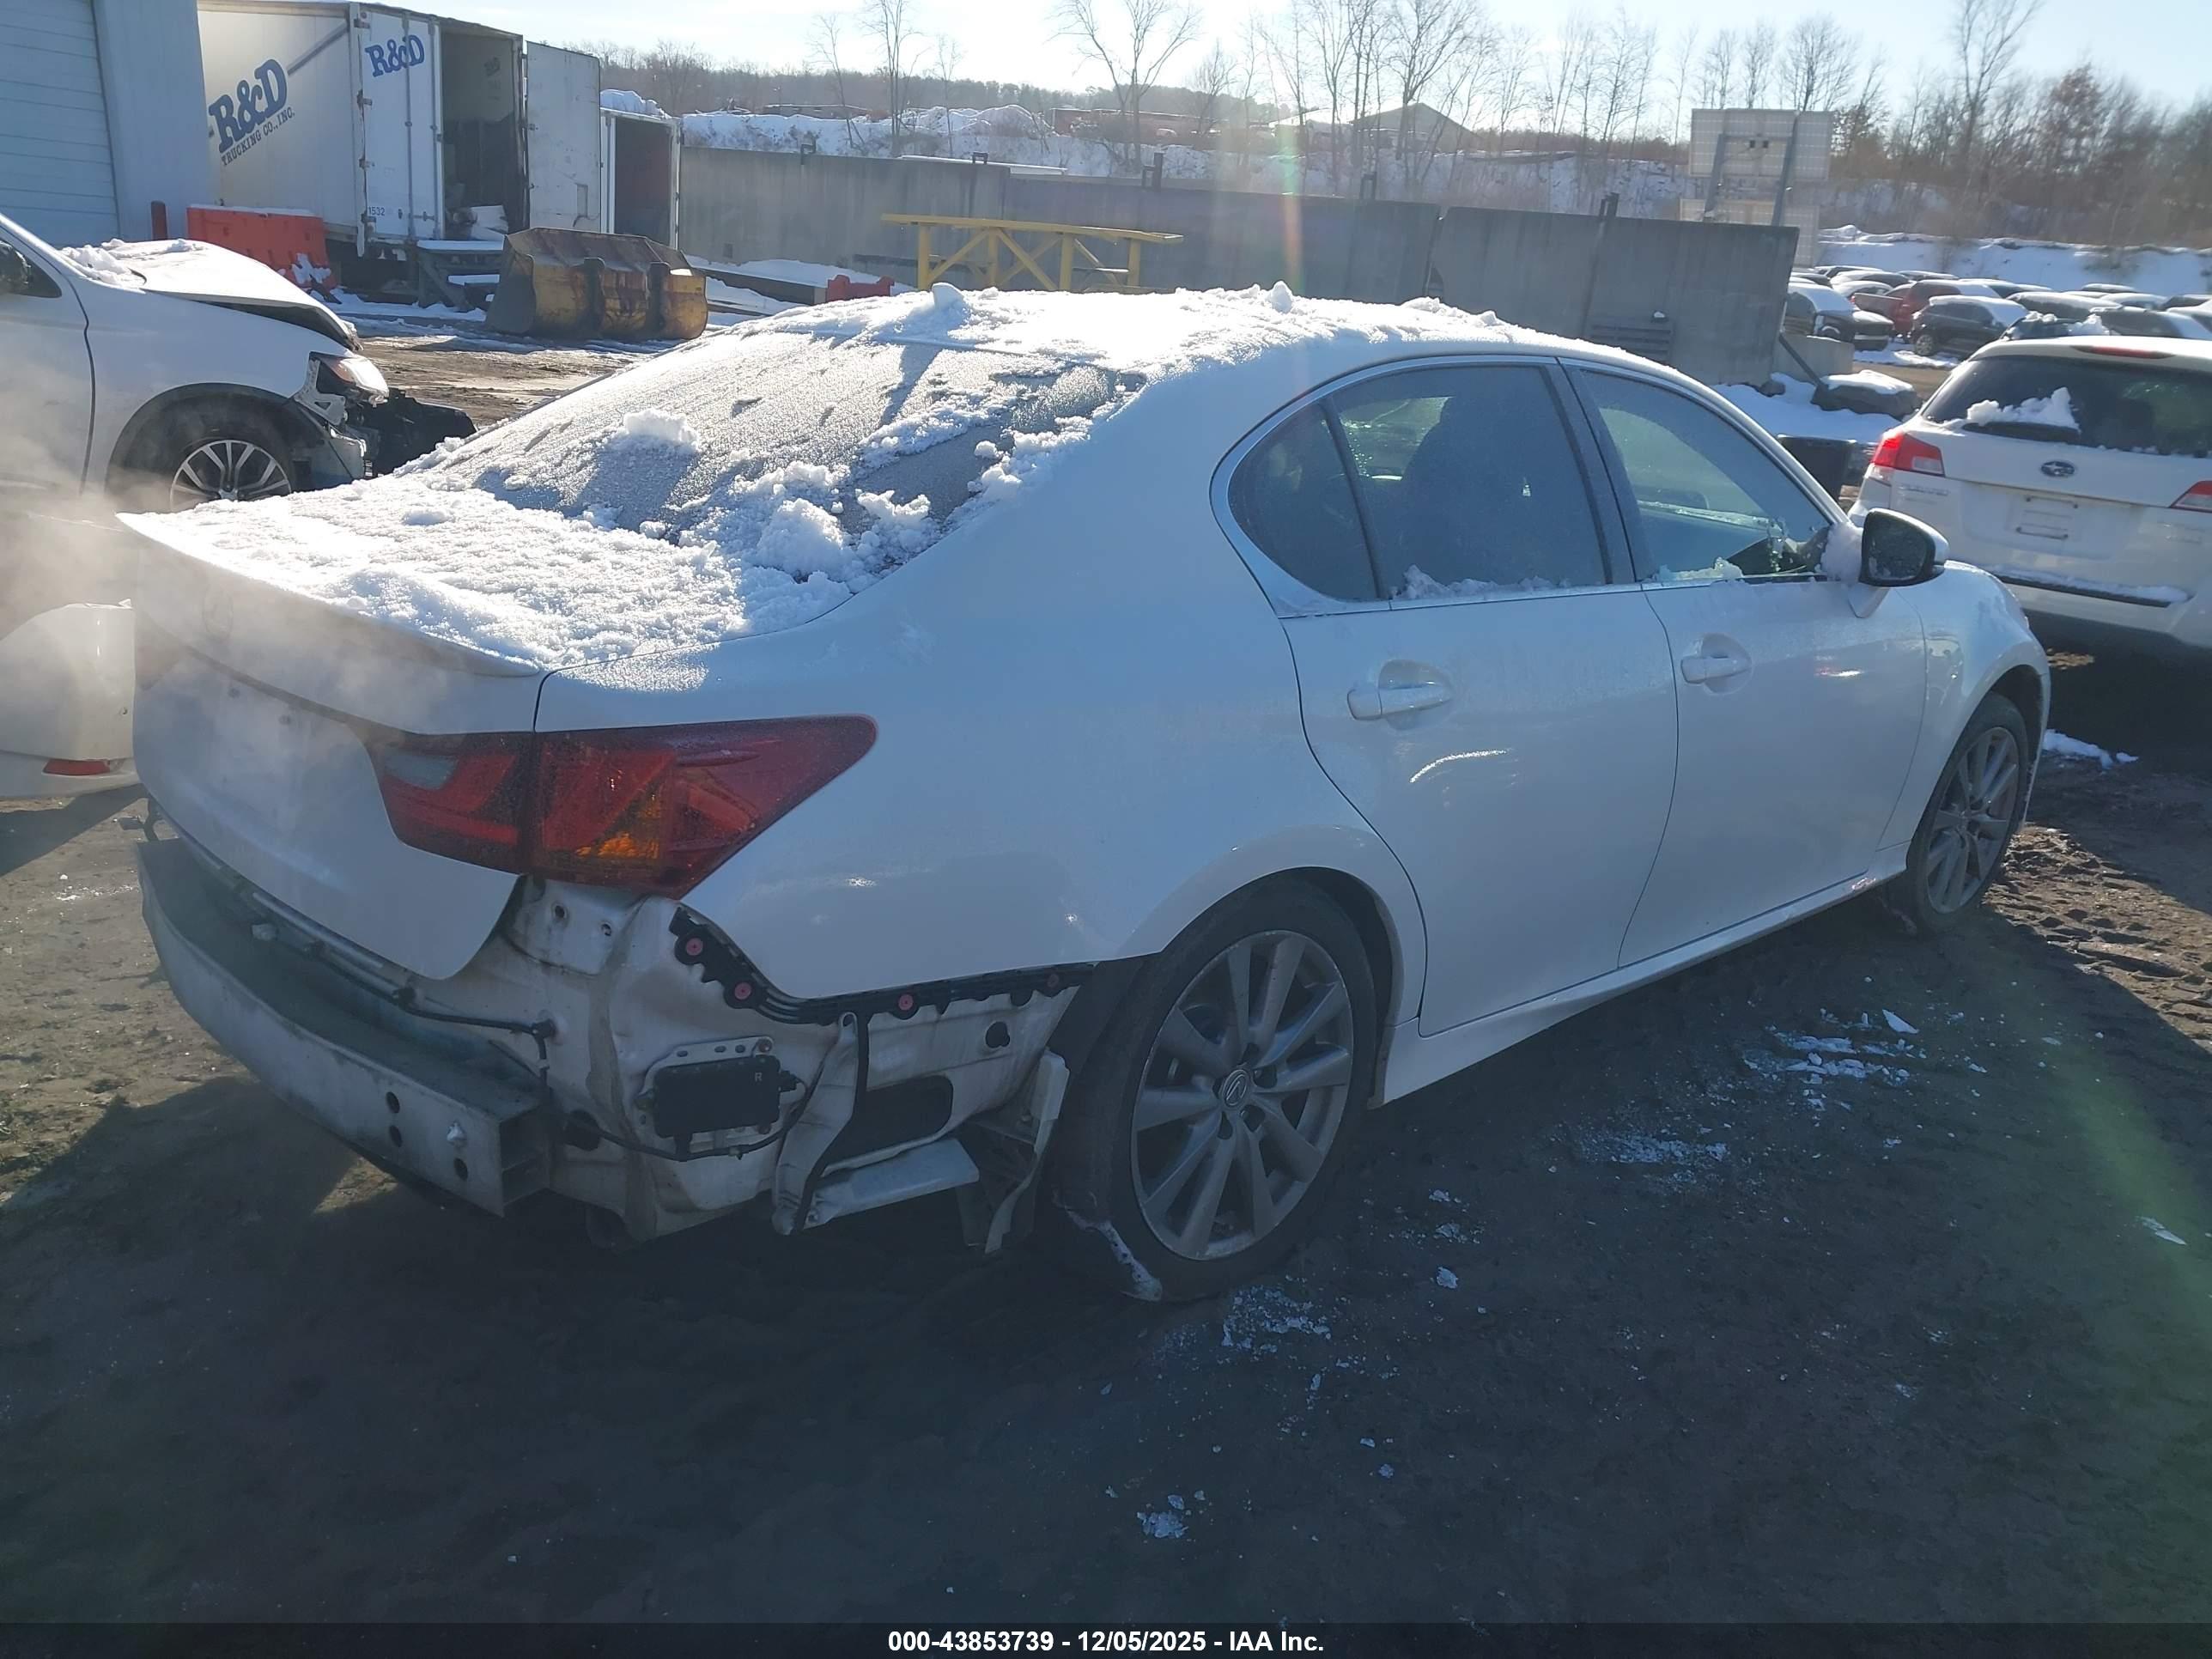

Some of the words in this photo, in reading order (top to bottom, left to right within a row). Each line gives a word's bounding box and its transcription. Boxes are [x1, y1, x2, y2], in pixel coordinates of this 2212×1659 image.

[365, 34, 424, 76] R&D
[209, 59, 287, 153] R&D
[222, 130, 262, 166] TRUCKING
[368, 206, 386, 216] 1532
[755, 1072, 763, 1082] R
